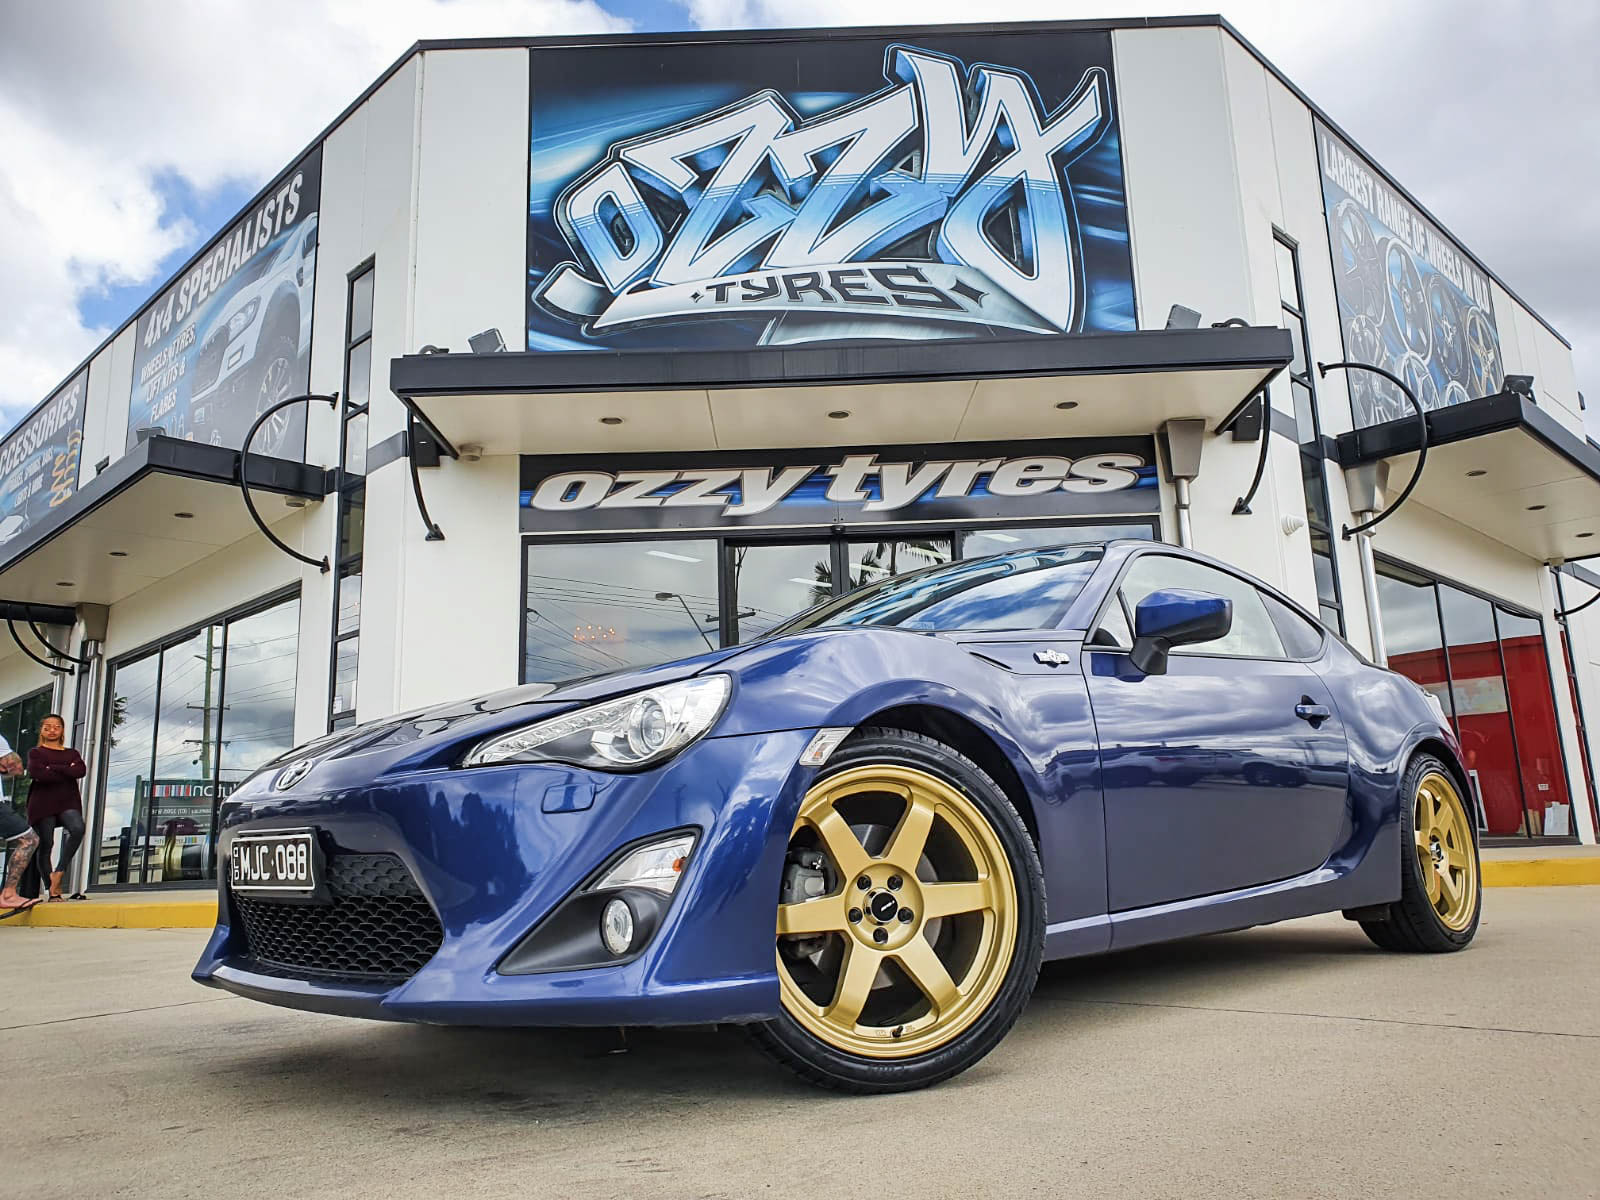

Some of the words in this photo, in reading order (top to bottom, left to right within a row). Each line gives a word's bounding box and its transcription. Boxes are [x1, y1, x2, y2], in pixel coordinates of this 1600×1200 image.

[566, 48, 1104, 332] OZZY
[1322, 134, 1375, 213] LARGEST
[1375, 182, 1412, 247] RANGE
[1411, 215, 1426, 259] OF
[1425, 226, 1464, 290] WHEELS
[176, 173, 303, 322] SPECIALISTS
[705, 265, 968, 313] TYRES
[531, 464, 816, 516] ozzy
[825, 453, 1144, 511] tyres
[240, 845, 270, 880] MJC
